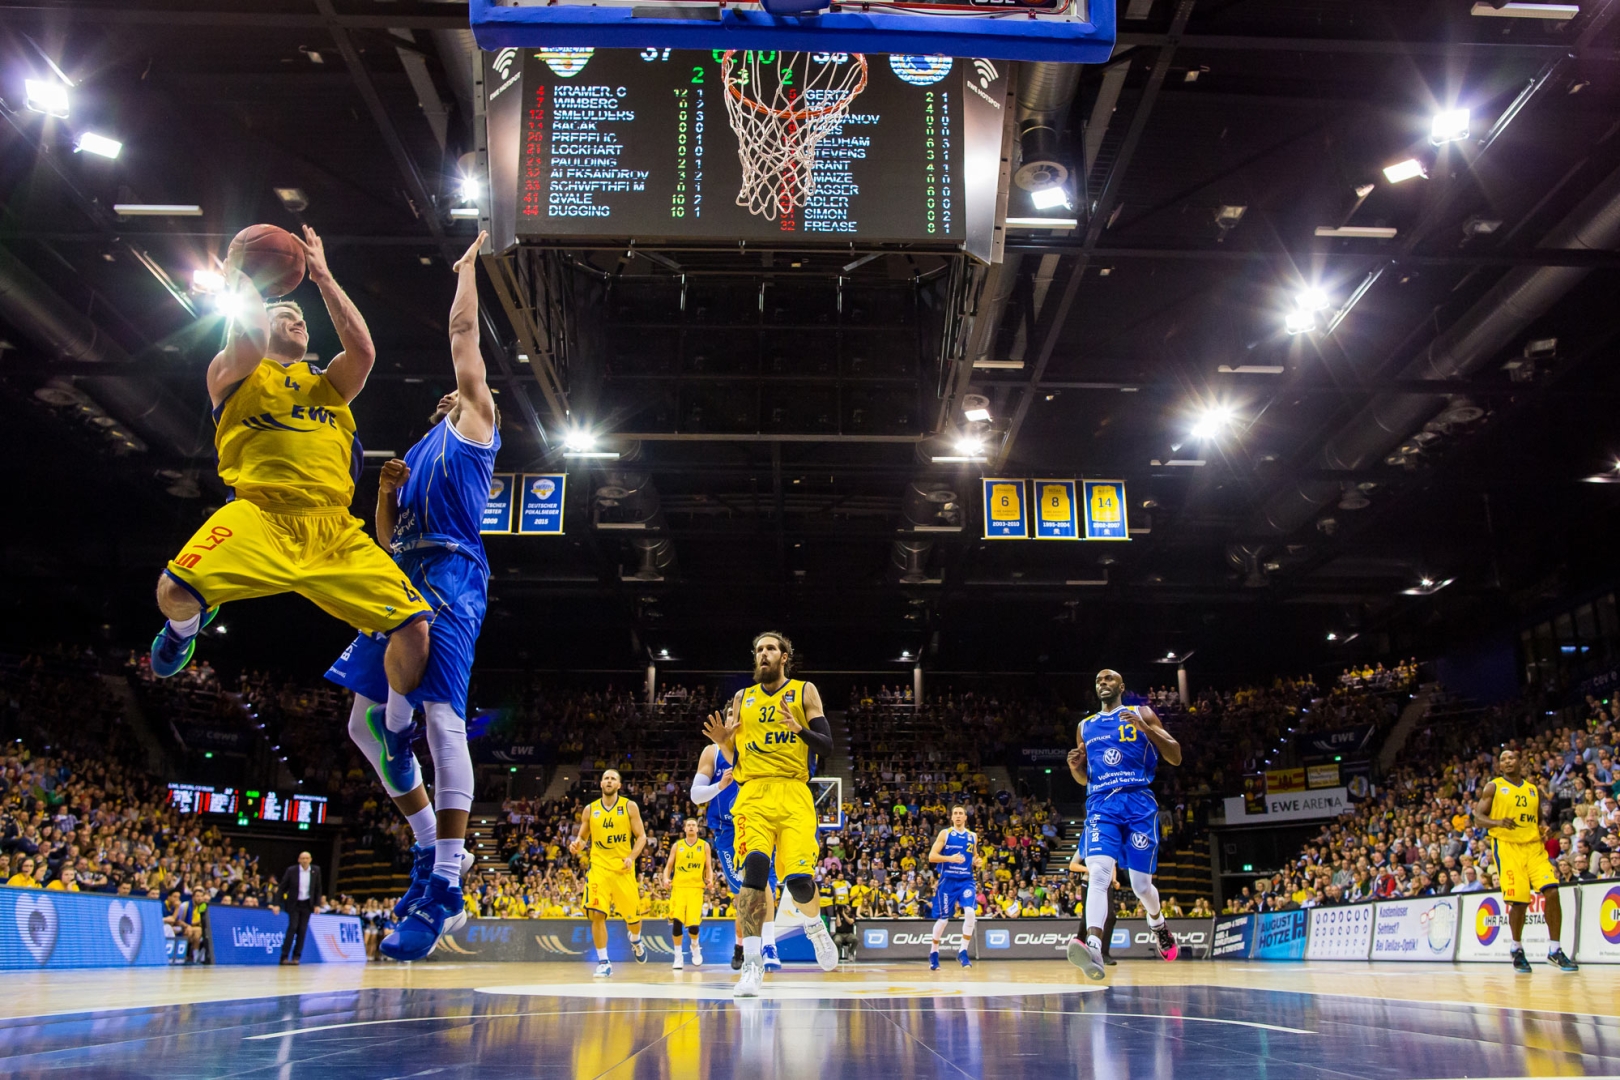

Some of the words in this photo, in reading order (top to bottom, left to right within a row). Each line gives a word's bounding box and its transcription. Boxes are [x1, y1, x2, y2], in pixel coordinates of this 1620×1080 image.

[691, 67, 704, 83] 2
[781, 69, 793, 84] 2
[551, 144, 623, 155] LOCKHART
[549, 193, 593, 204] QVALE
[804, 196, 849, 207] ADLER
[804, 208, 847, 220] SIMON
[285, 376, 300, 392] 4
[291, 404, 337, 431] EWE
[1001, 496, 1009, 506] 6
[1051, 496, 1059, 507] 8
[1098, 497, 1111, 507] 14
[401, 579, 422, 603] 4
[759, 706, 775, 723] 32
[765, 731, 797, 744] EWE
[1118, 724, 1137, 742] 13
[1331, 732, 1355, 744] EWE
[511, 746, 534, 755] EWE
[1272, 800, 1299, 813] EWE
[1302, 797, 1342, 811] ARENA
[1515, 795, 1528, 807] 23
[603, 818, 614, 829] 44
[607, 834, 626, 844] EWE
[1379, 906, 1408, 918] Kostenloser
[1261, 914, 1291, 932] AUGUST
[1485, 916, 1497, 926] IHR
[339, 923, 361, 943] EWE
[466, 925, 512, 943] EWE
[1377, 922, 1400, 935] Sehtest?
[1259, 929, 1290, 949] HOTZE
[1376, 940, 1384, 951] Bei
